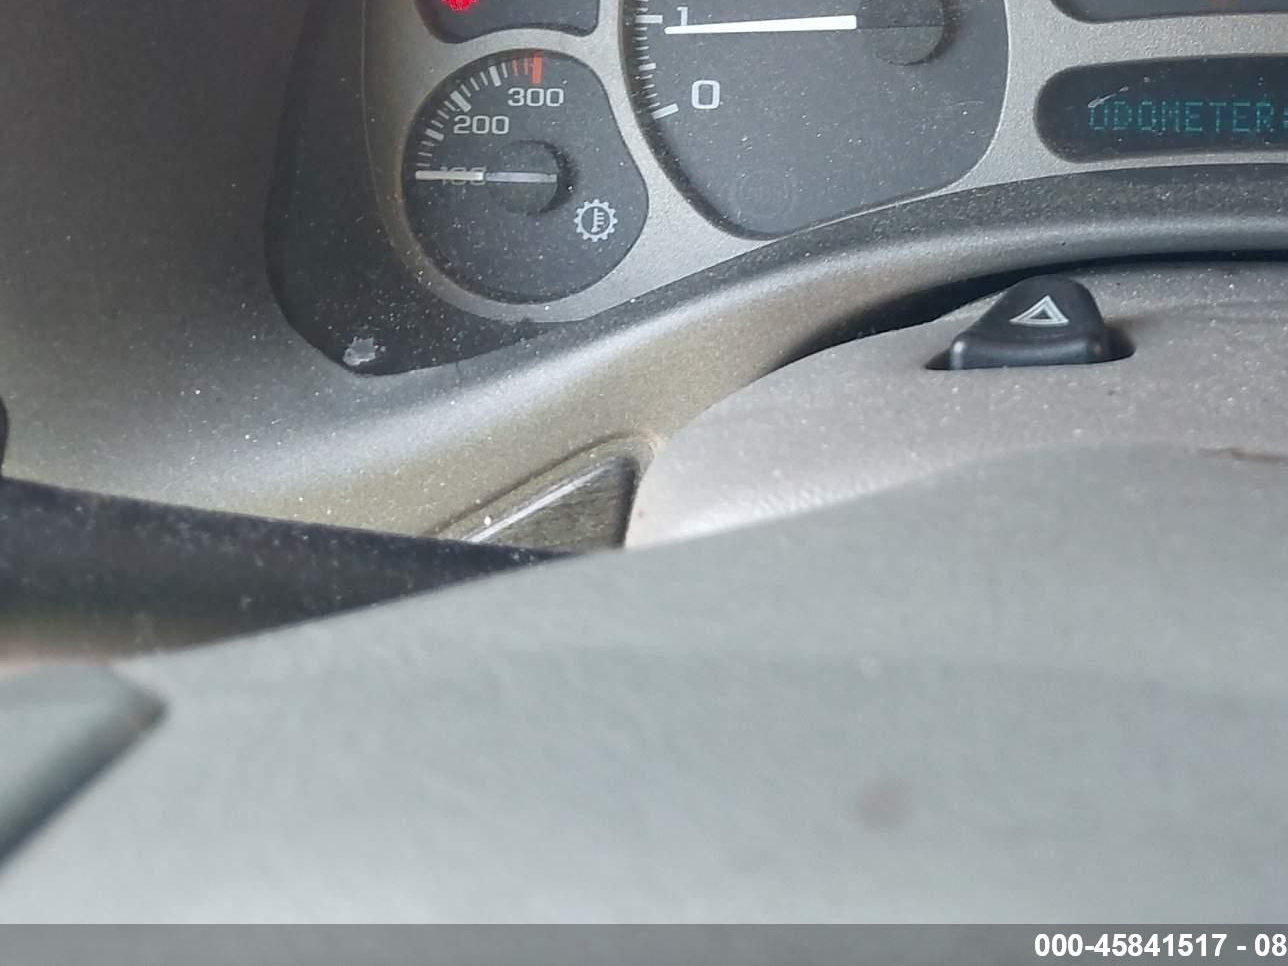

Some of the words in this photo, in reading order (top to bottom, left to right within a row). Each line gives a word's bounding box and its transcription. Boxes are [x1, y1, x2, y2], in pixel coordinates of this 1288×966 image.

[677, 6, 688, 27] 1
[507, 87, 564, 107] 300
[691, 79, 721, 110] 0
[453, 115, 510, 135] 200
